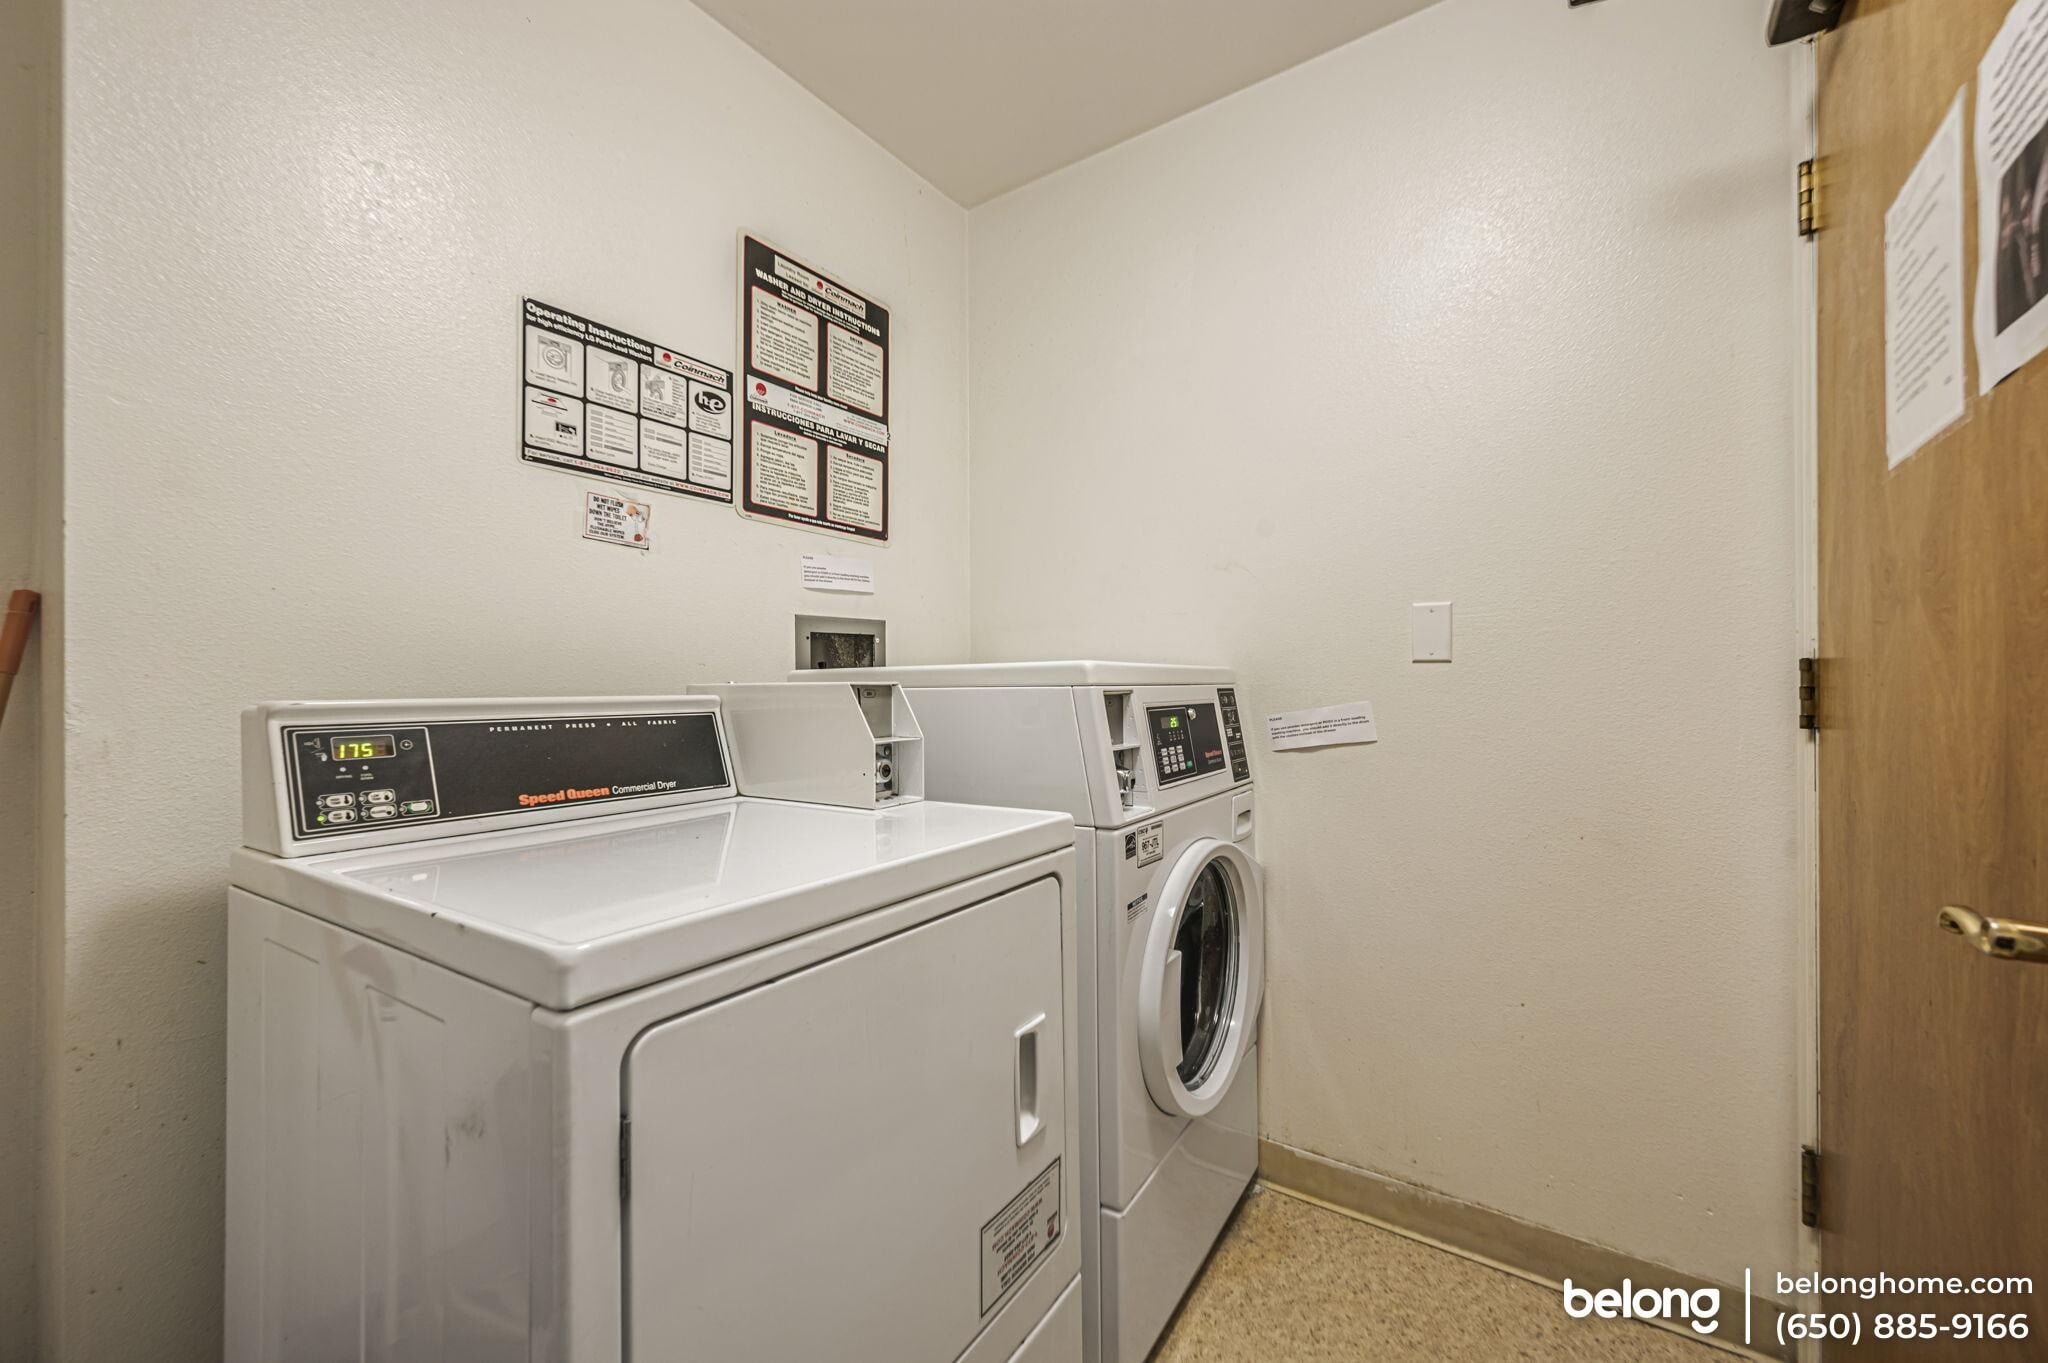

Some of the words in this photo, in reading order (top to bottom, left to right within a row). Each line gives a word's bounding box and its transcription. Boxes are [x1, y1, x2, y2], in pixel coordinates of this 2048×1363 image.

[755, 268, 789, 291] WASHER
[790, 285, 806, 299] AND
[807, 294, 831, 313] DRYER
[833, 307, 880, 337] INSTRUCTIONS
[825, 287, 864, 312] Coinmach
[526, 302, 586, 332] Operating
[588, 323, 653, 354] Instructions
[537, 317, 553, 328] high
[553, 323, 585, 340] efficiency
[674, 360, 725, 384] Coinmach
[752, 402, 814, 430] INSTRUCCIONES
[816, 423, 835, 436] PARA
[836, 430, 857, 443] LAVAR
[865, 440, 885, 453] SECAR
[489, 724, 553, 733] PERMANENT
[339, 742, 373, 759] 175
[518, 790, 565, 806] Speed
[567, 786, 610, 800] Queen
[612, 781, 656, 795] Commercial
[657, 779, 677, 791] Dryer
